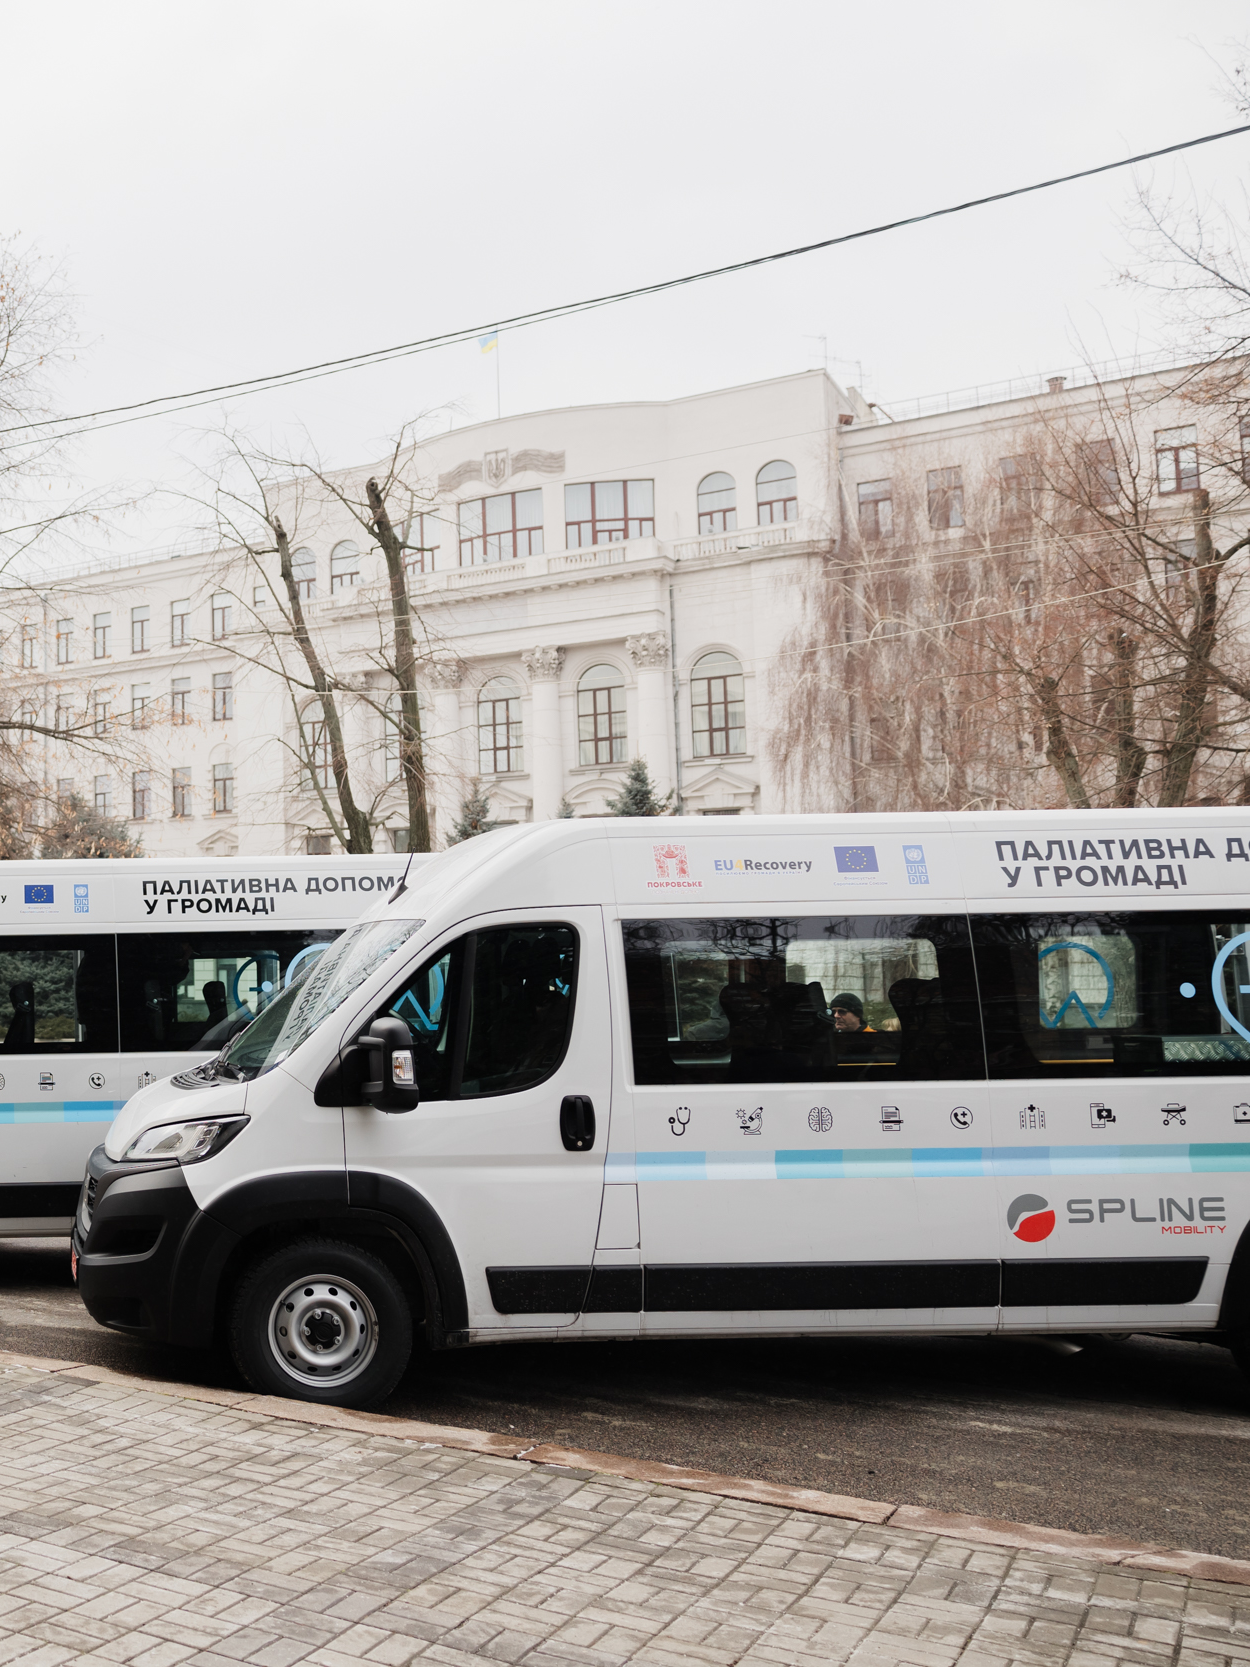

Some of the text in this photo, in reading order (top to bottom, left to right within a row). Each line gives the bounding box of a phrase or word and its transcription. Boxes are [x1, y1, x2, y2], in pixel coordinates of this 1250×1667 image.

[995, 837, 1250, 862] ПАЛІАТИВНА Д
[714, 859, 812, 873] EU4Recovery
[908, 865, 926, 873] UN
[909, 875, 927, 884] DP
[1000, 864, 1188, 889] У ГРОМАДІ
[142, 877, 298, 896] ПАЛІАТИВНА
[145, 897, 275, 915] У ГРОМАДІ
[1066, 1197, 1226, 1223] SPLINE
[1161, 1225, 1227, 1234] MOBILITY
